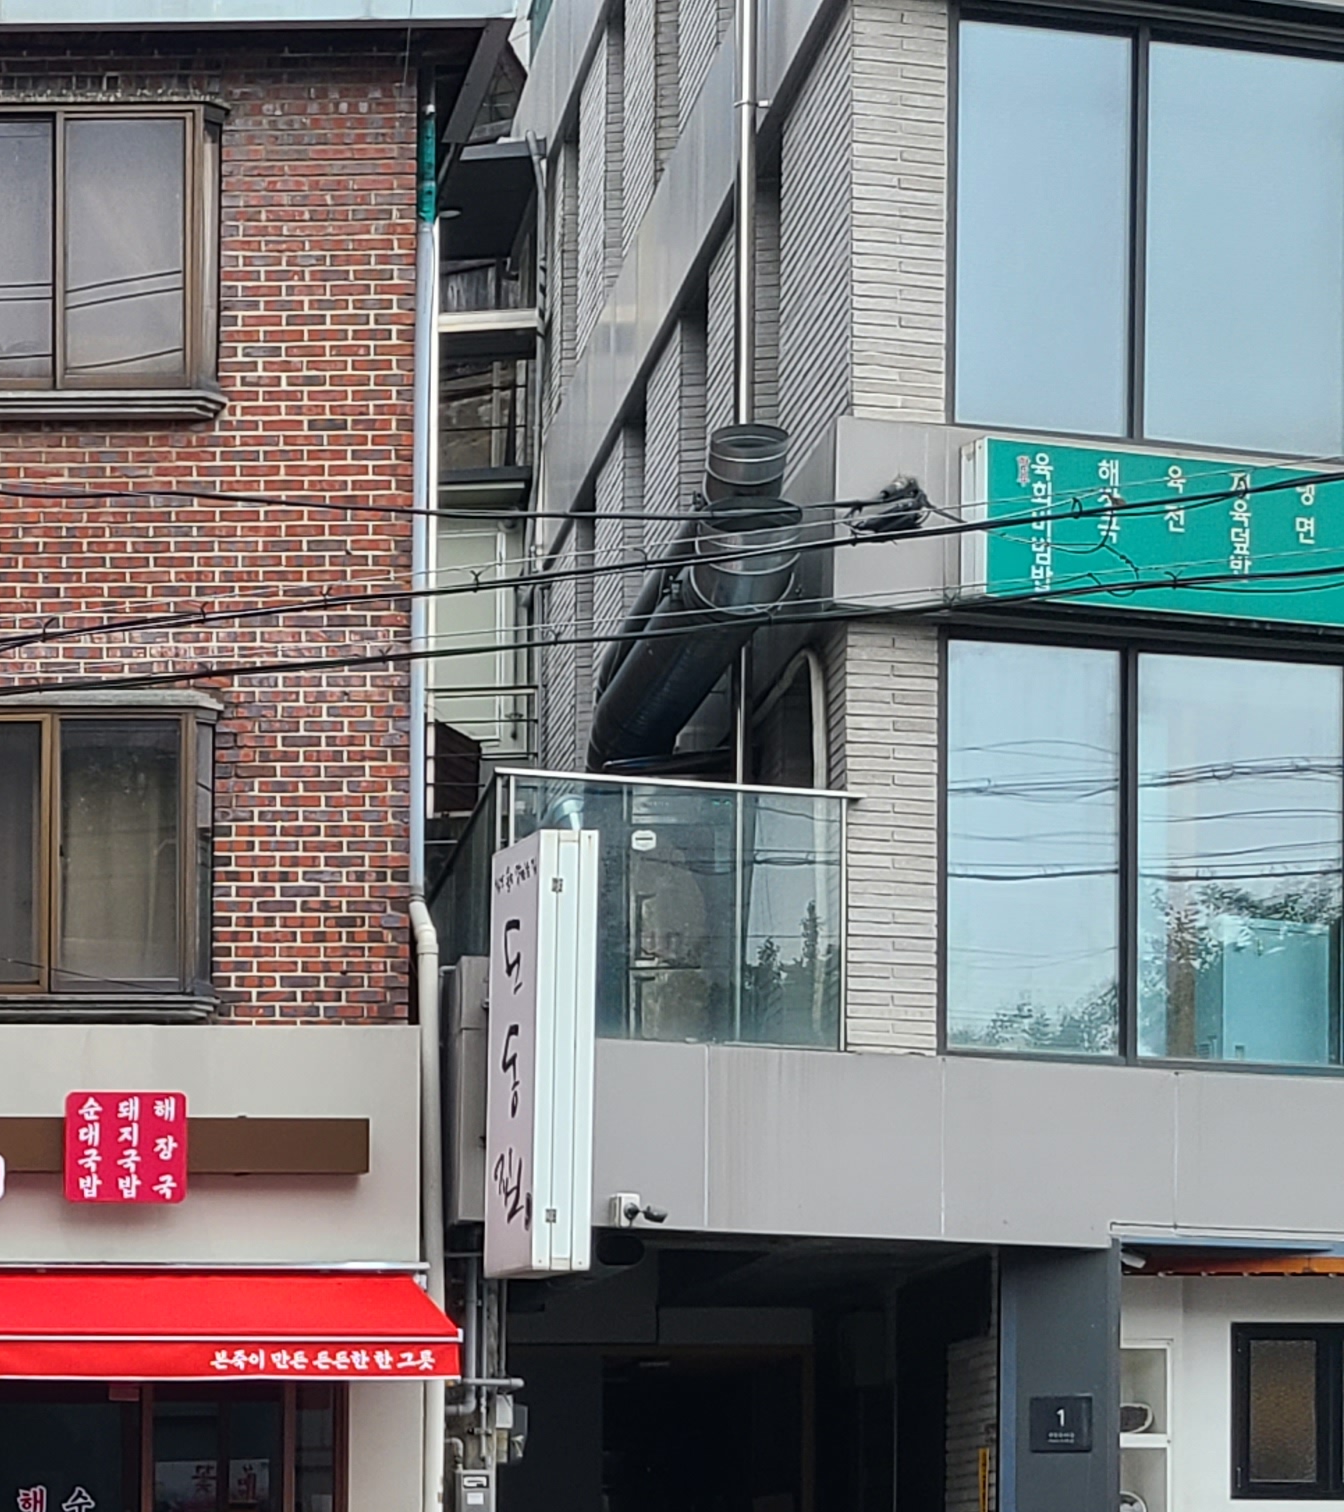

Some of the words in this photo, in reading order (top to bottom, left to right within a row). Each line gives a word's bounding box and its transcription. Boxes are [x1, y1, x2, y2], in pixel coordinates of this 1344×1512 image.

[77, 1096, 103, 1199] 순대국밥
[116, 1095, 142, 1199] 돼지국밥
[152, 1096, 178, 1200] 해장국
[210, 1348, 265, 1371] 본죽이
[270, 1349, 309, 1371] 만든
[312, 1349, 369, 1371] 든든한
[373, 1349, 394, 1371] 한
[396, 1349, 436, 1371] 그릇
[1056, 1408, 1065, 1428] 1
